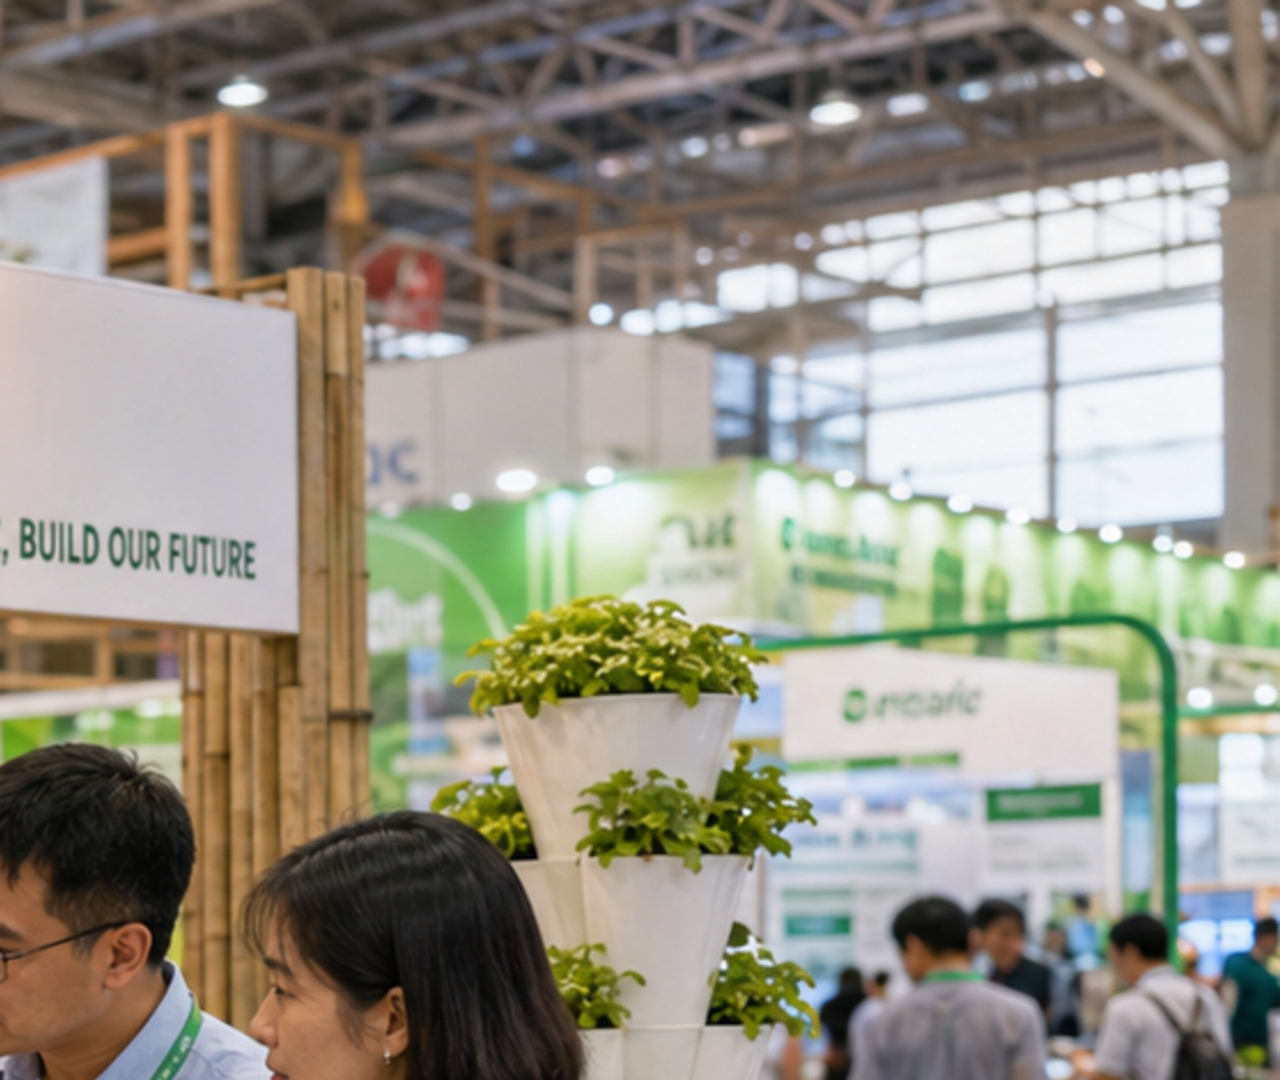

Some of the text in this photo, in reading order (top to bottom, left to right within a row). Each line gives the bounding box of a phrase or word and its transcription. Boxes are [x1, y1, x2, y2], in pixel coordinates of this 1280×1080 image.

[19, 517, 100, 565] BUILD
[108, 526, 161, 572] OUR
[169, 532, 256, 580] FUTURE
